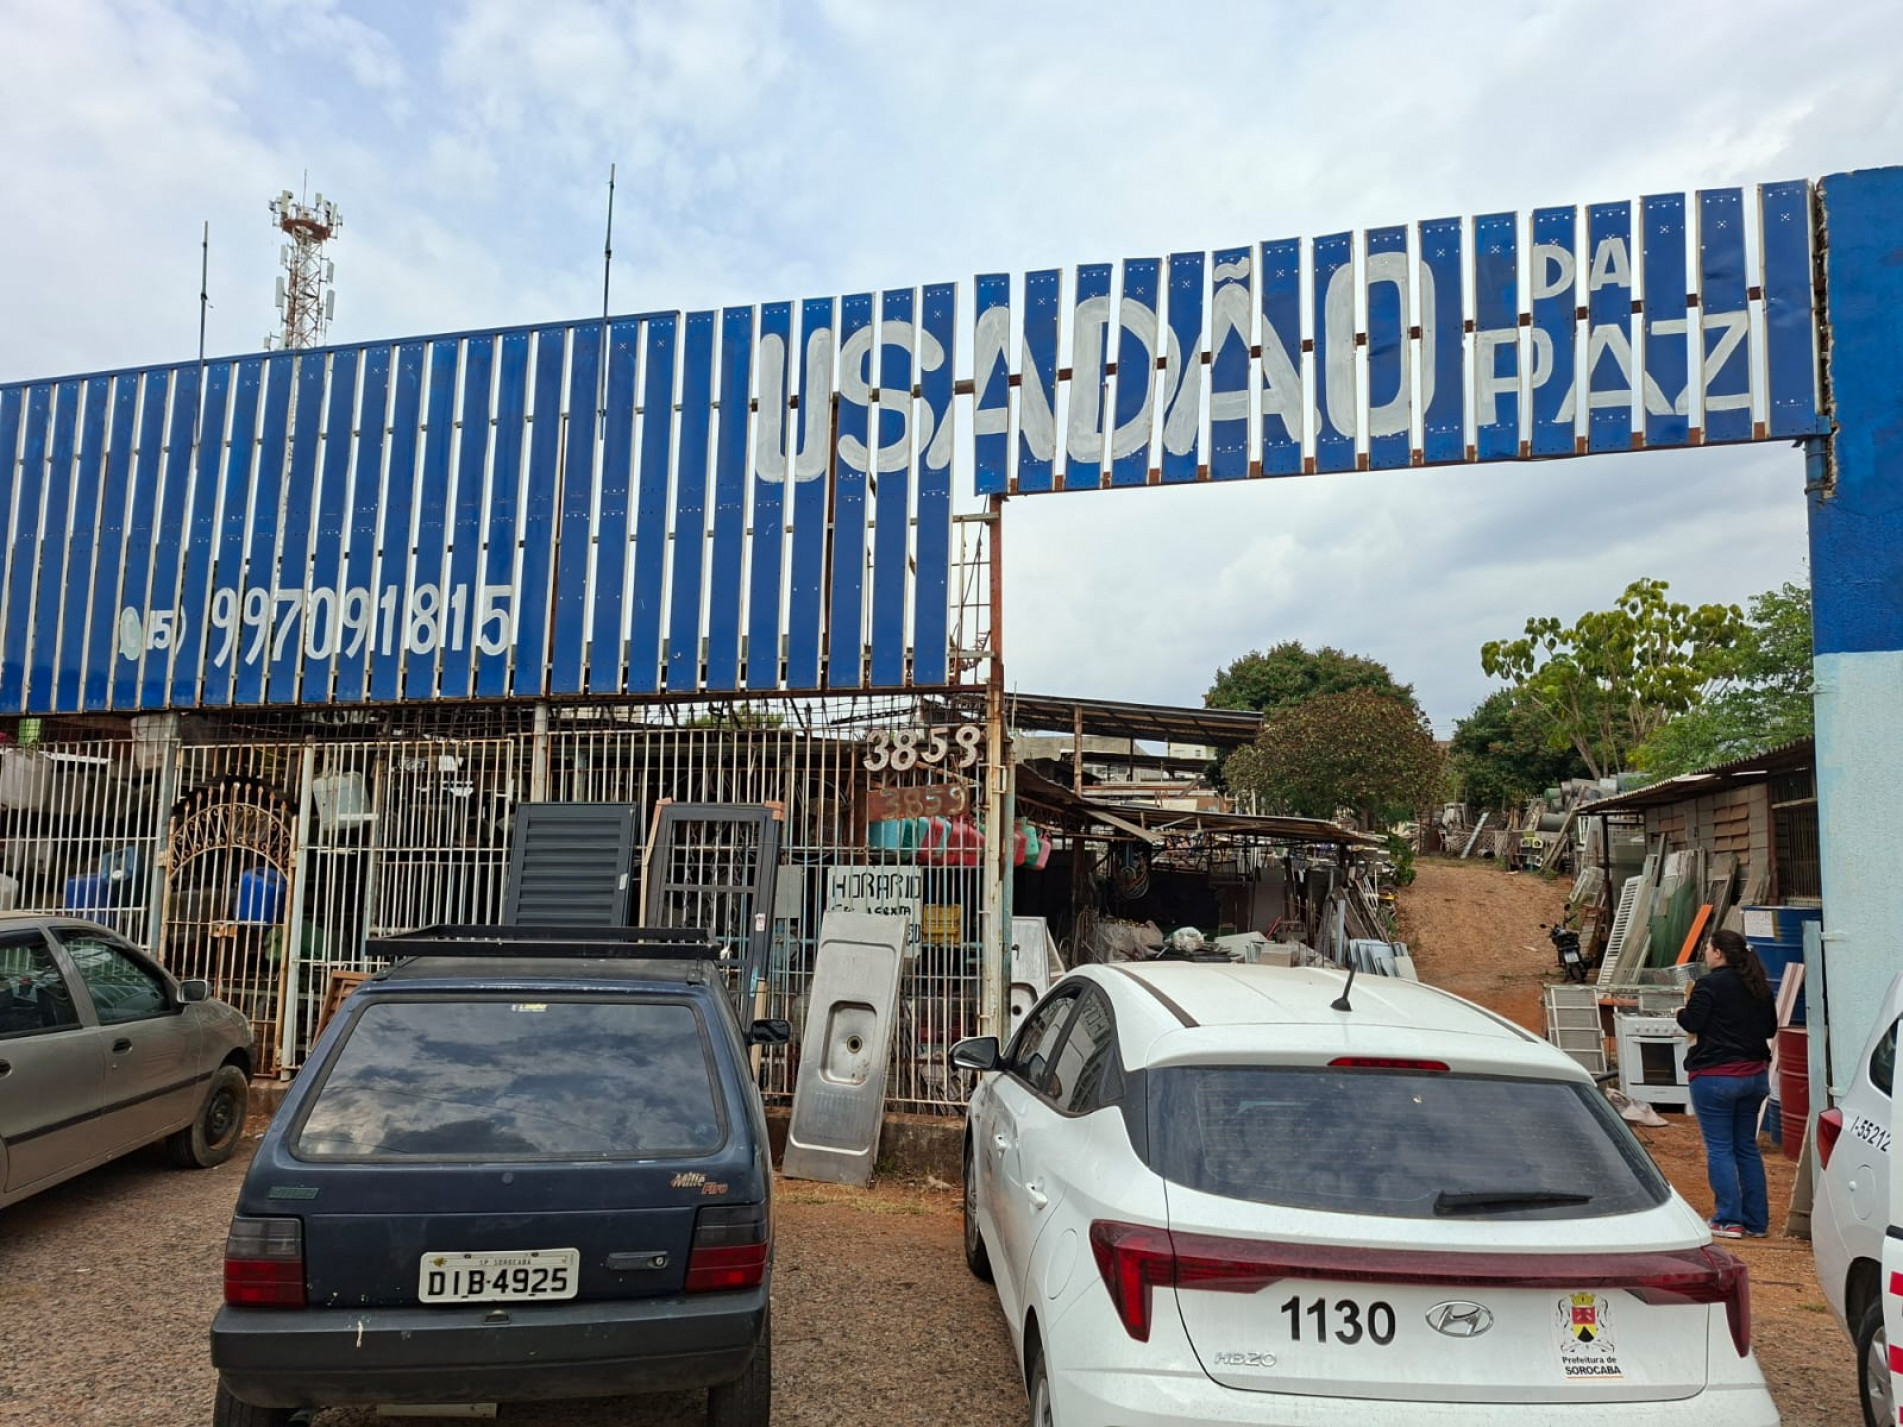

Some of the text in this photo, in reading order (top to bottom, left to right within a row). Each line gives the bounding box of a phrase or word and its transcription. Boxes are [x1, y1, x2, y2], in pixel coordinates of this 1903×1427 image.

[1532, 237, 1632, 300] DA
[753, 252, 1436, 484] USADÃO
[1474, 311, 1751, 425] PAZ
[212, 583, 513, 669] 997091815
[863, 725, 981, 772] 3859
[1280, 1296, 1396, 1346] 1130
[1562, 1356, 1617, 1364] Prefeitura de
[1565, 1365, 1622, 1375] SOROCABA
